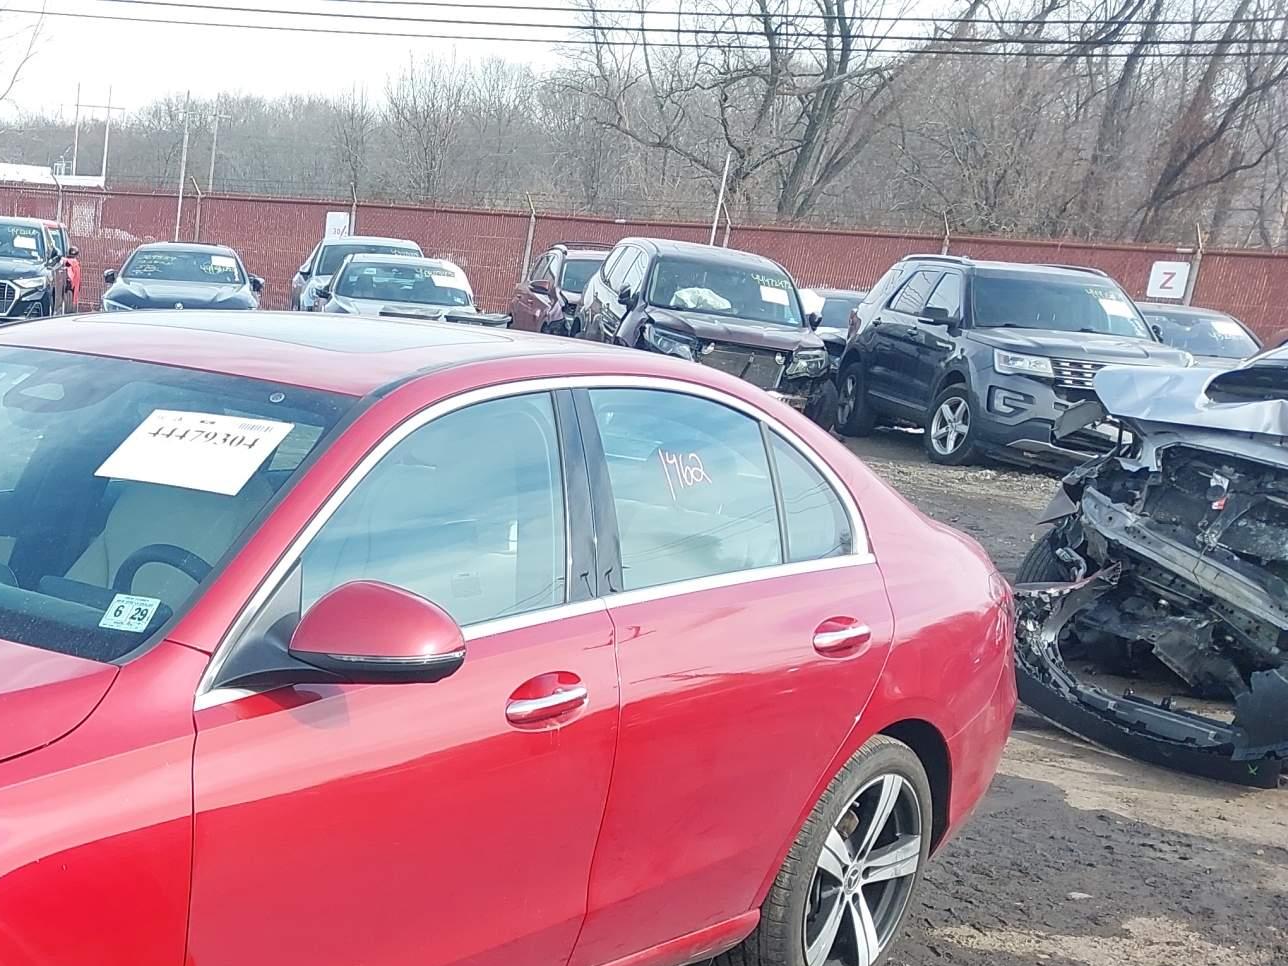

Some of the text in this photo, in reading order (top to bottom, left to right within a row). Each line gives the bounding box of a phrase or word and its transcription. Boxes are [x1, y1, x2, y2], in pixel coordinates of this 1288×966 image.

[1160, 271, 1177, 290] Z
[148, 426, 260, 449] 44479304
[658, 447, 713, 501] 1462
[113, 604, 149, 622] 6 29
